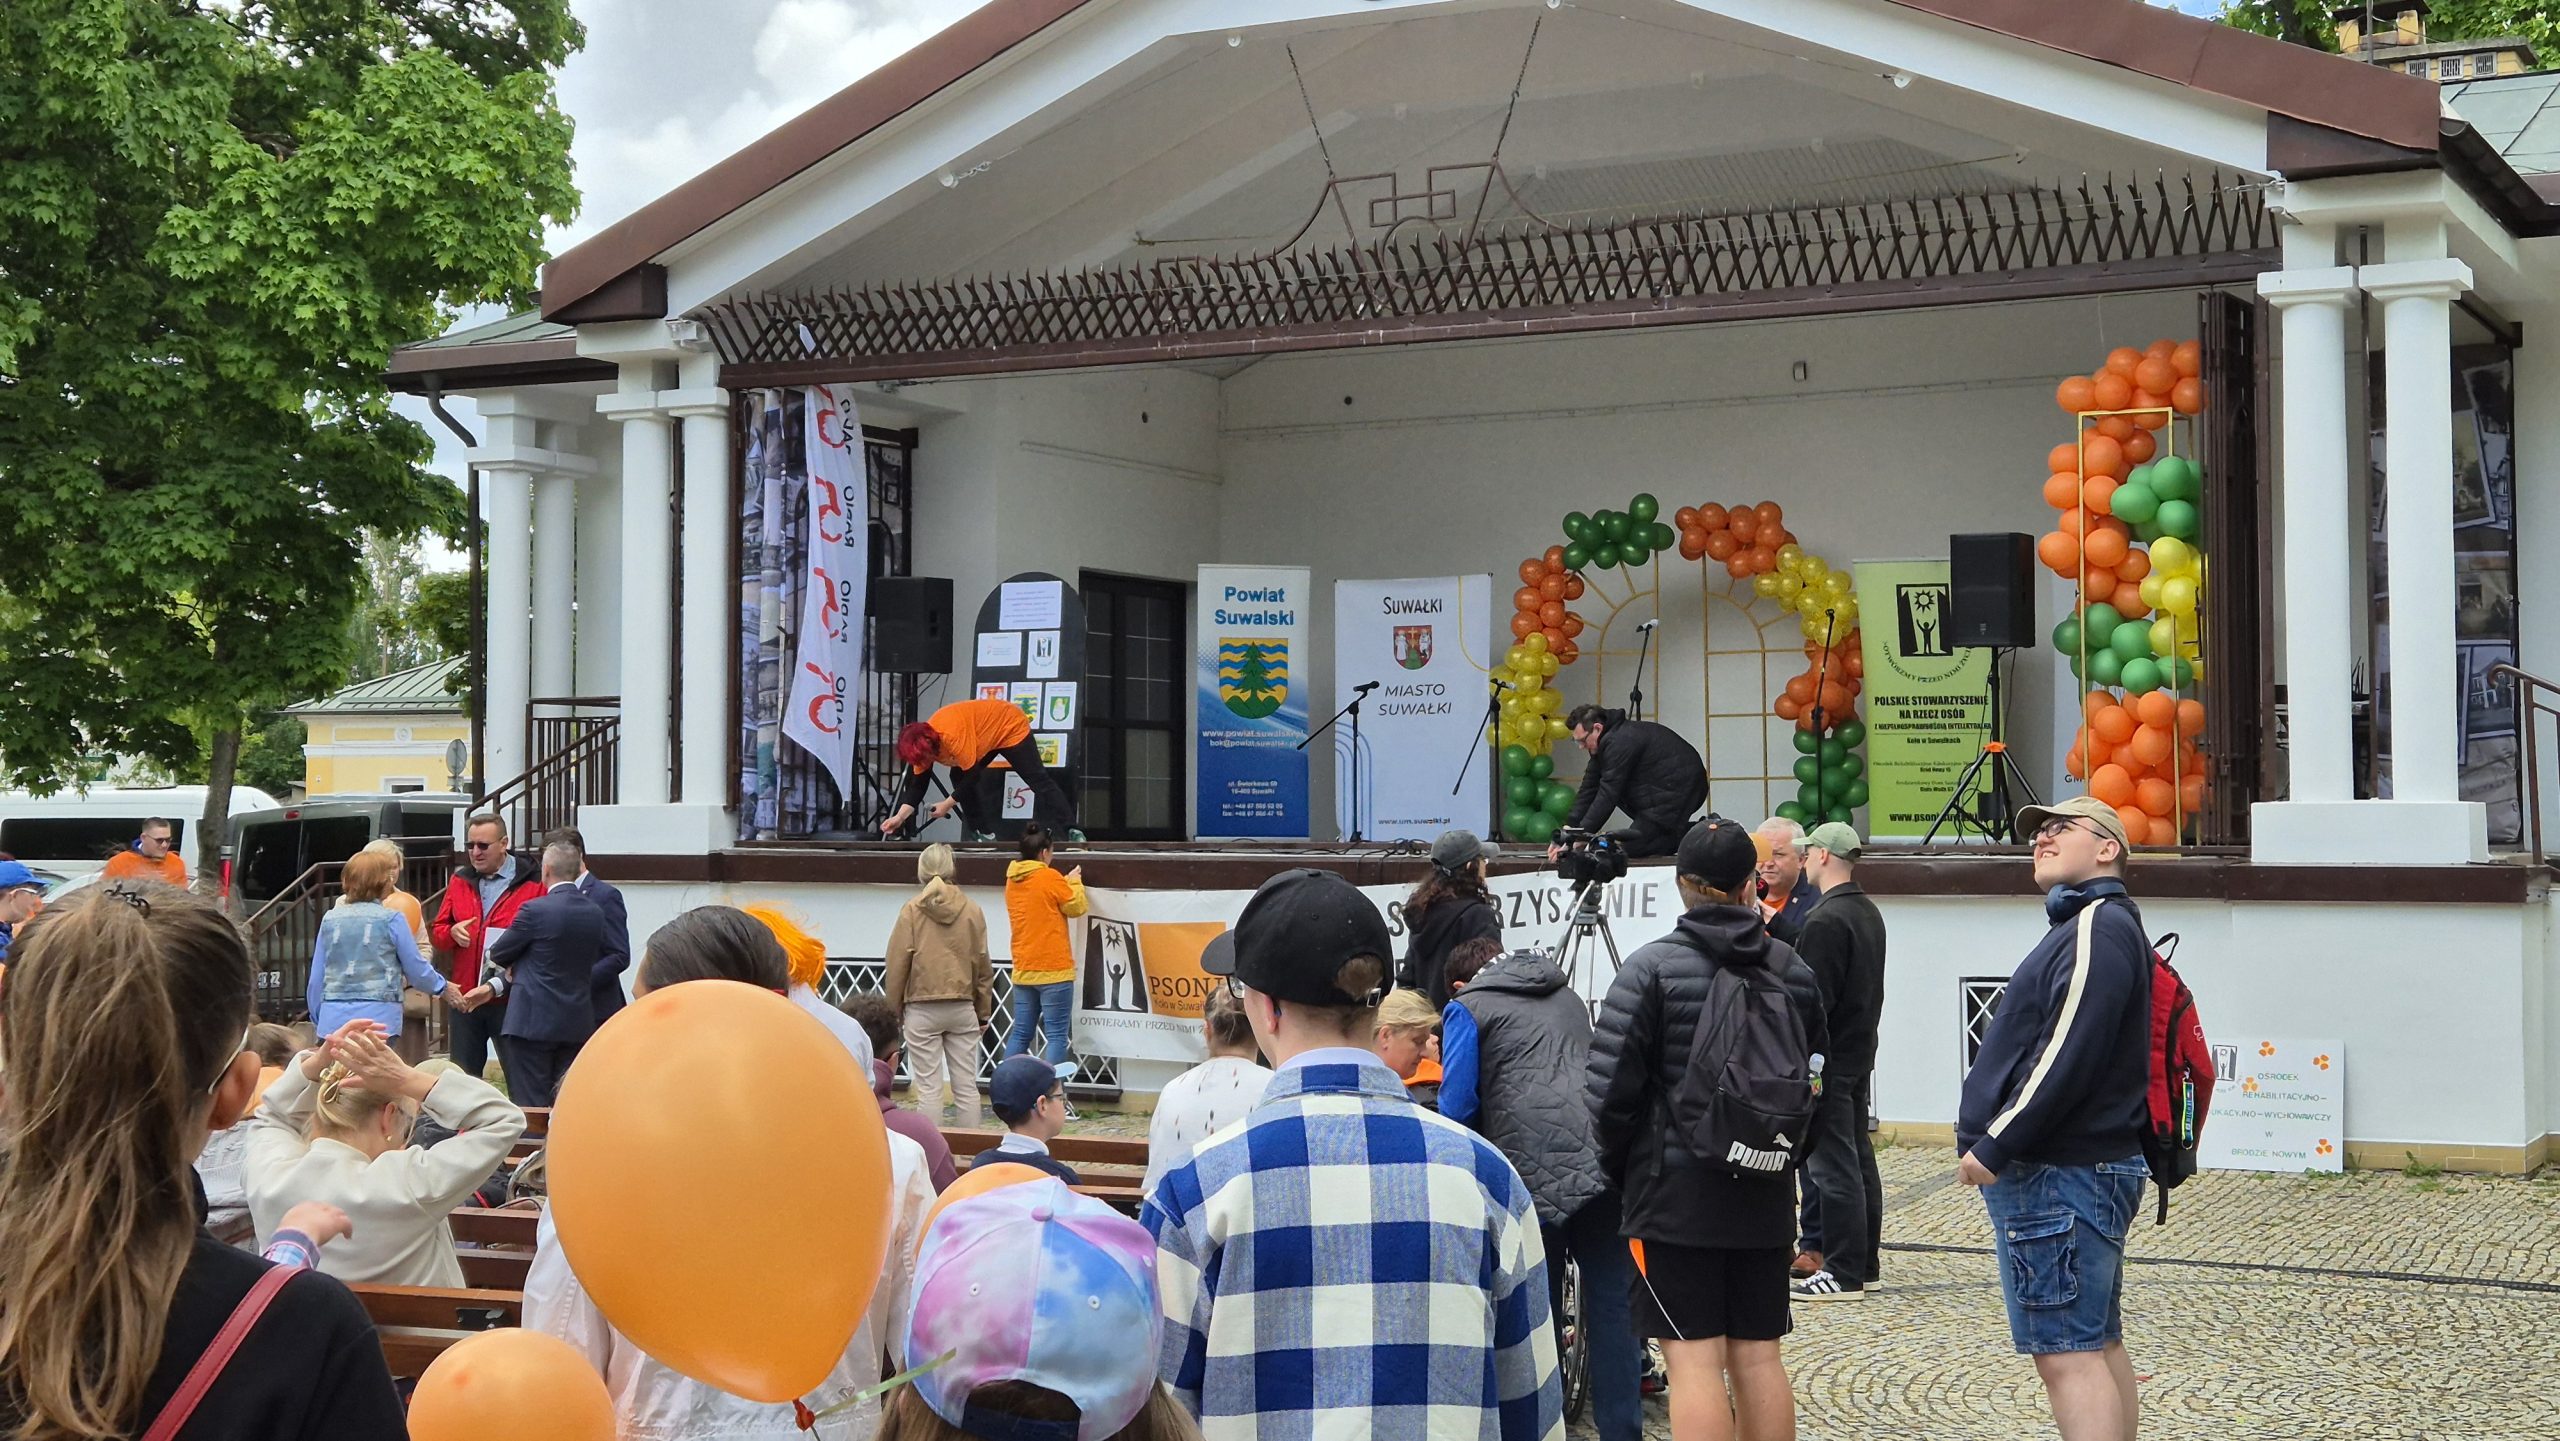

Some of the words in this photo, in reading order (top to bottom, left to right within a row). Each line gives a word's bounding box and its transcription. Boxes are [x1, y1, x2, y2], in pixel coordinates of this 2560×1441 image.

[1224, 586, 1285, 602] Powiat
[1214, 609, 1294, 626] Suwalski
[1385, 683, 1446, 698] MIASTO
[1874, 695, 1909, 706] POLSKIE
[1911, 695, 1989, 706] STOWARZYSZENIE
[1378, 702, 1452, 716] SUWAŁKI
[1899, 710, 1911, 719] NA
[1914, 709, 1939, 719] RZECZ
[1941, 708, 1965, 719] OSÓB
[1080, 1016, 1143, 1030] OTWIERAMY
[1145, 1020, 1175, 1032] PRZED
[1726, 1140, 1791, 1171] PUMA
[2272, 1150, 2306, 1159] NOWYM
